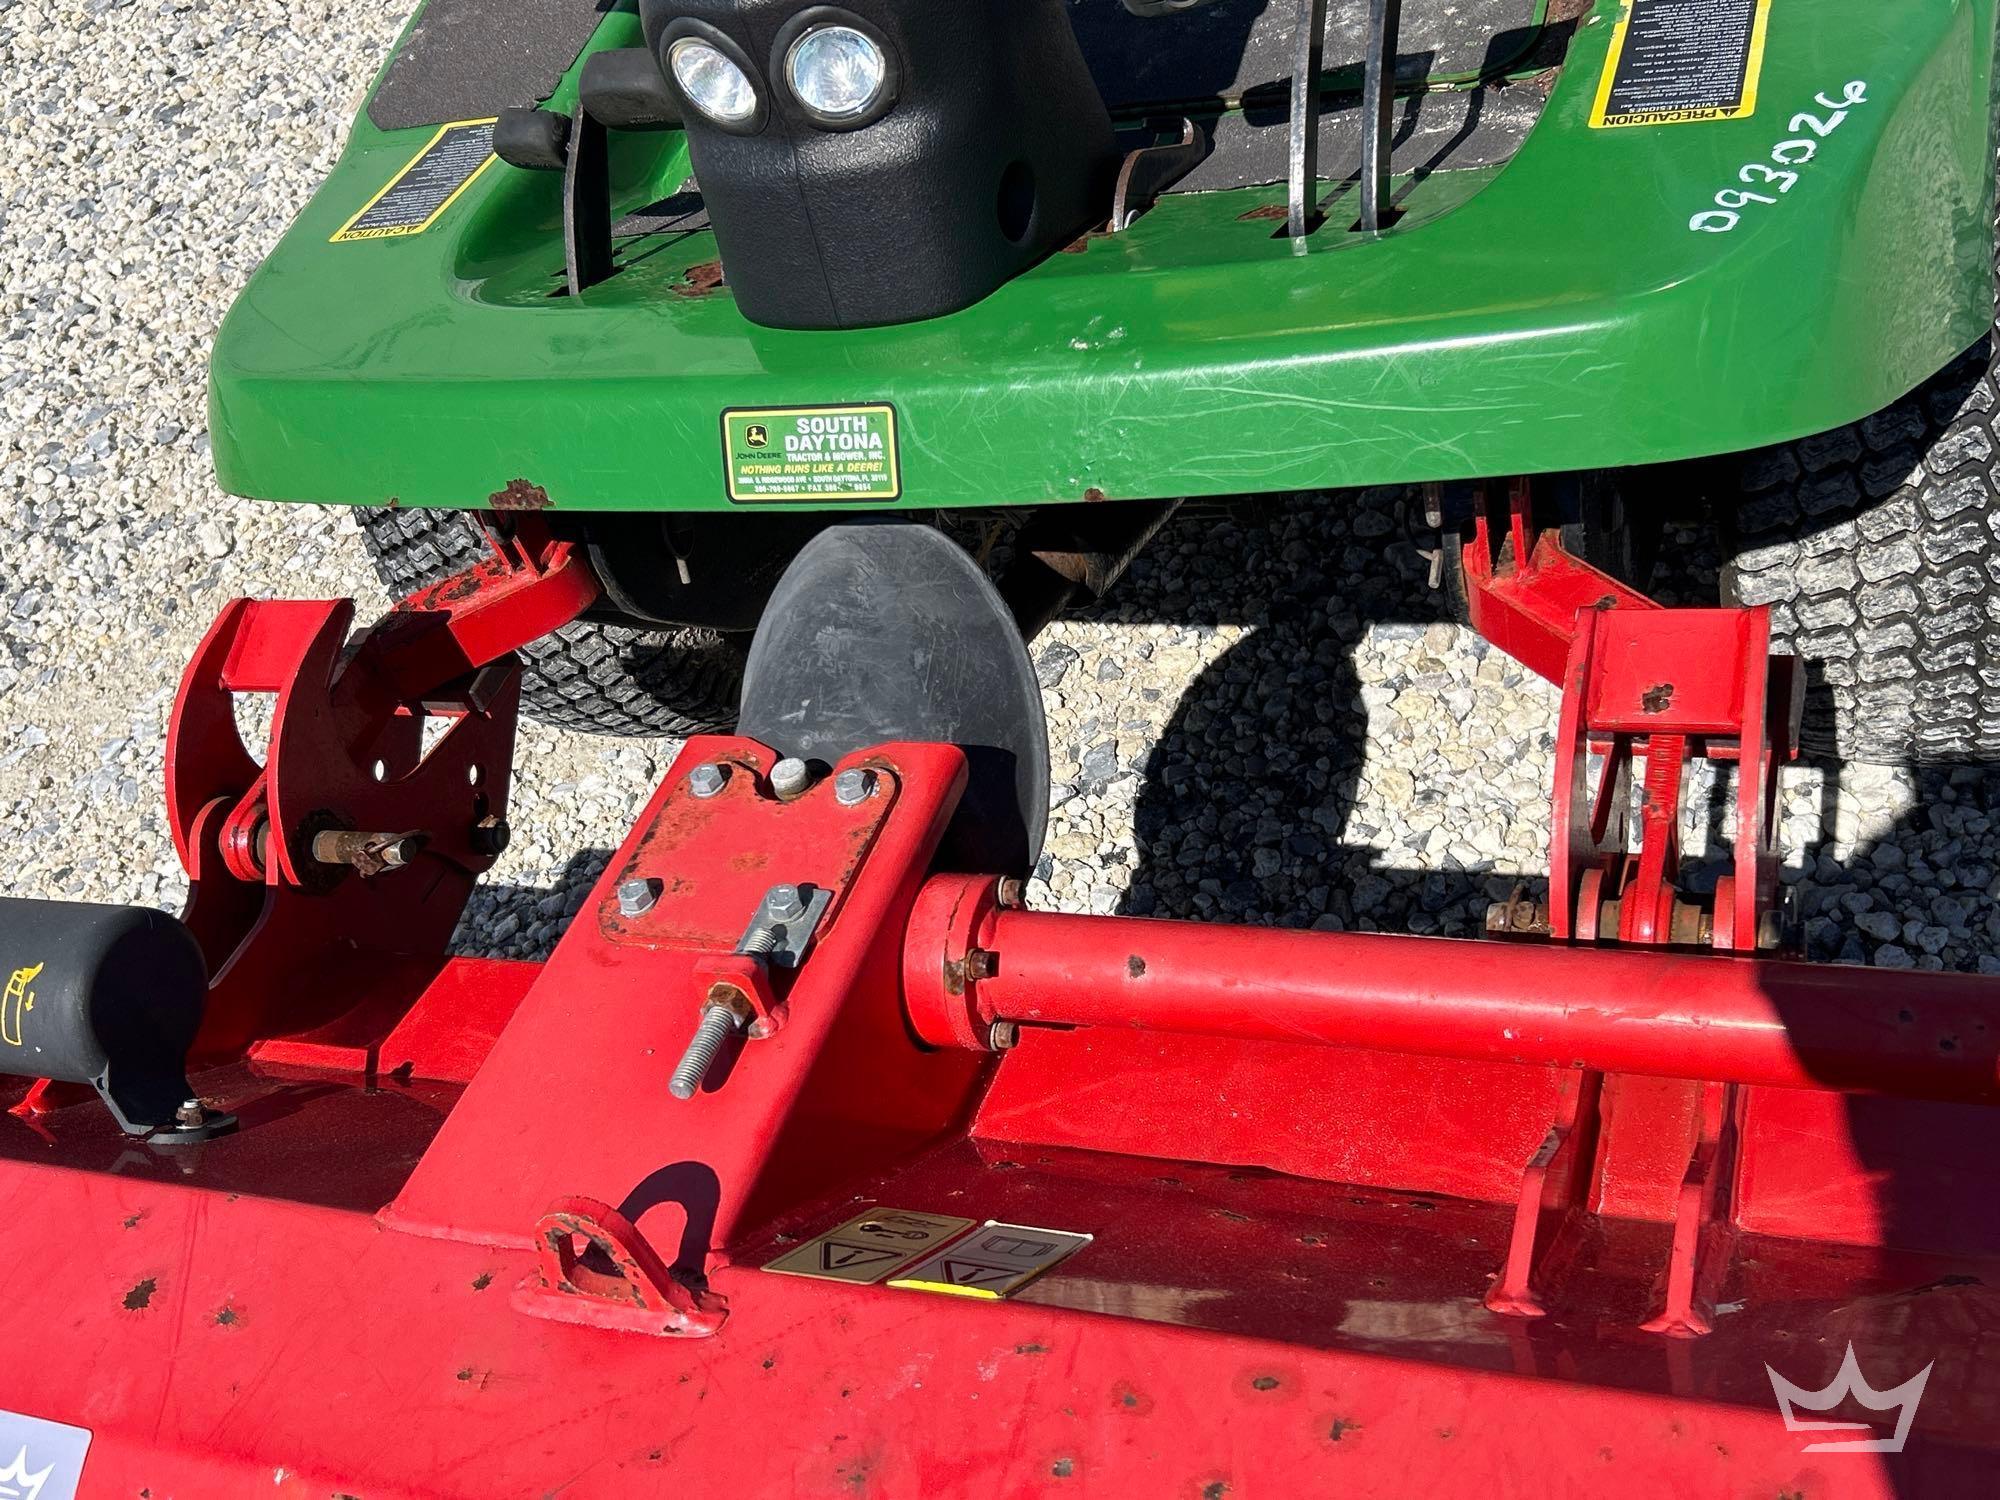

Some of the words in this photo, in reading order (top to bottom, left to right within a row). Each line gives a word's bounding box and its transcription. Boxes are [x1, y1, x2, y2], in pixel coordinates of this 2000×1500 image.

[1603, 109, 1717, 125] PRECAUCION
[1689, 81, 1867, 232] 093026
[338, 226, 405, 240] CAUTION
[796, 416, 868, 434] SOUTH
[784, 432, 883, 451] DAYTONA
[735, 452, 756, 460] JOHN
[786, 452, 823, 462] TRACTOR
[824, 452, 832, 461] &
[741, 465, 782, 475] NOTHING
[784, 464, 810, 474] RUNS
[813, 463, 835, 473] LIKE
[837, 463, 844, 472] A
[847, 462, 883, 472] DEERE!
[808, 484, 822, 492] FAX
